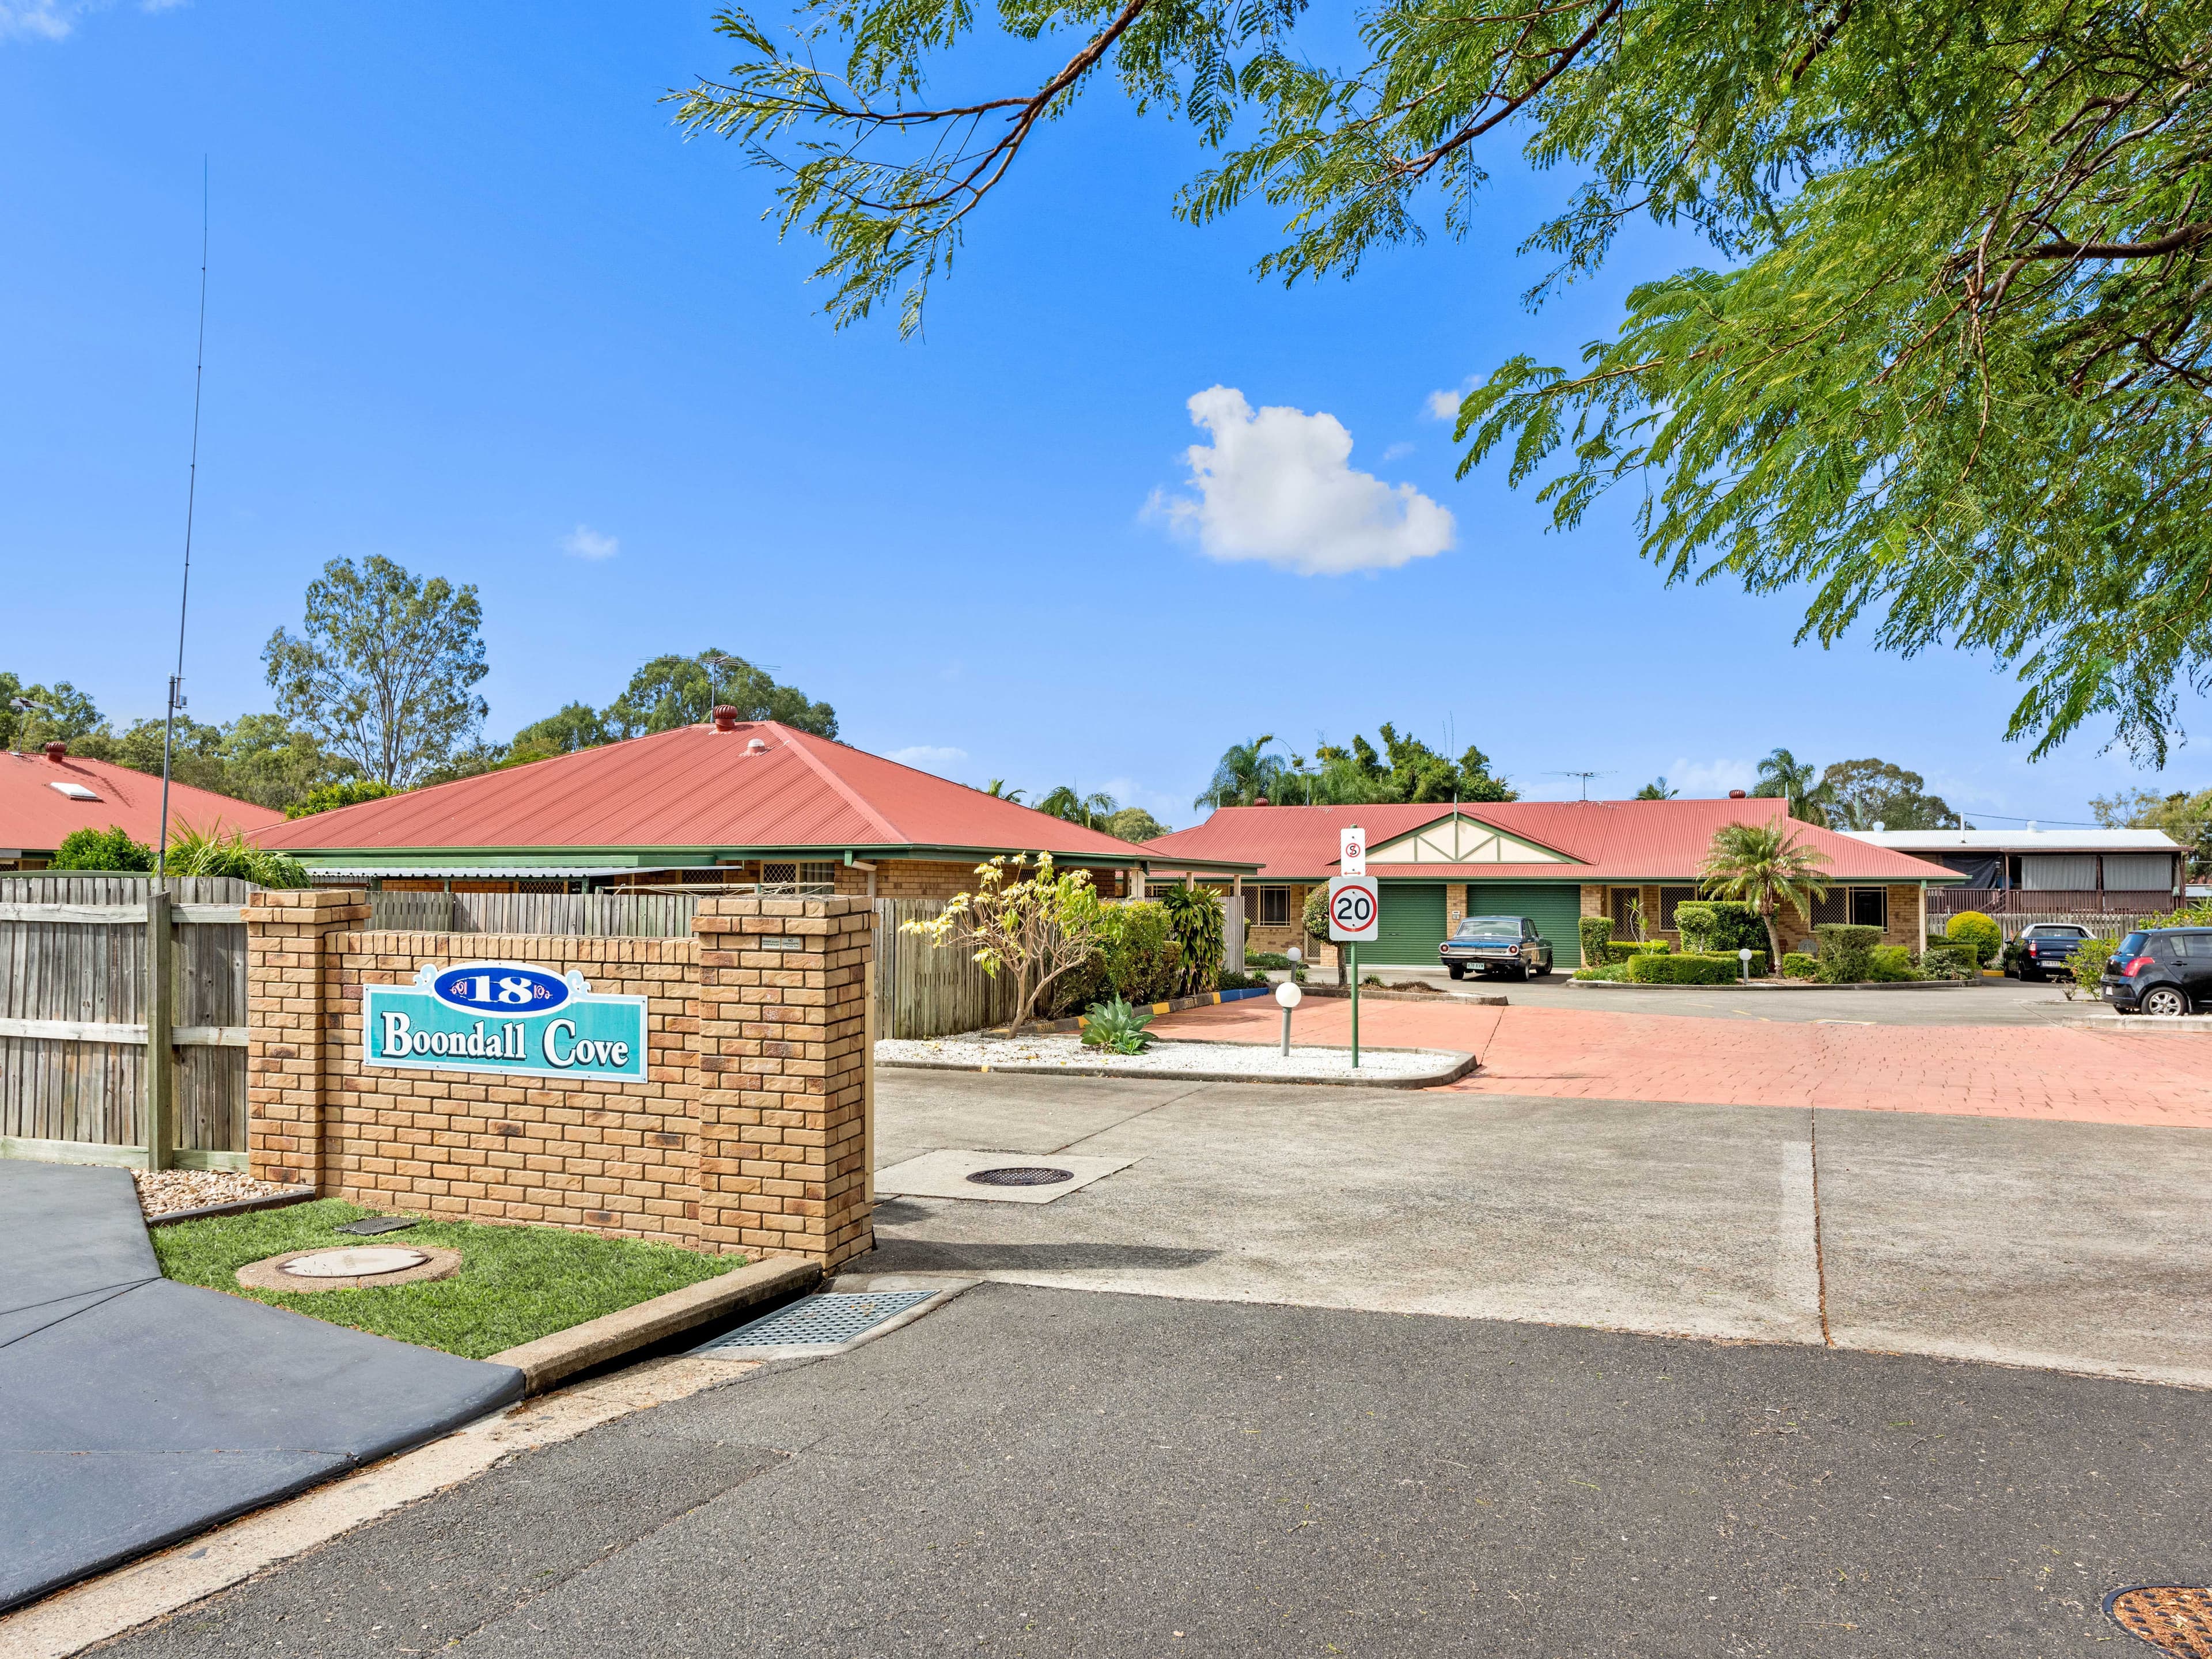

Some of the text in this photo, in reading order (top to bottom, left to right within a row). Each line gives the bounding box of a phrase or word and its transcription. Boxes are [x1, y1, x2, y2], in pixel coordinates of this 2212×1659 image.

[1337, 897, 1370, 920] 20
[468, 975, 533, 1004] 18
[381, 1010, 629, 1069] Boondall Cove
[1036, 1022, 1055, 1031] VISITOR
